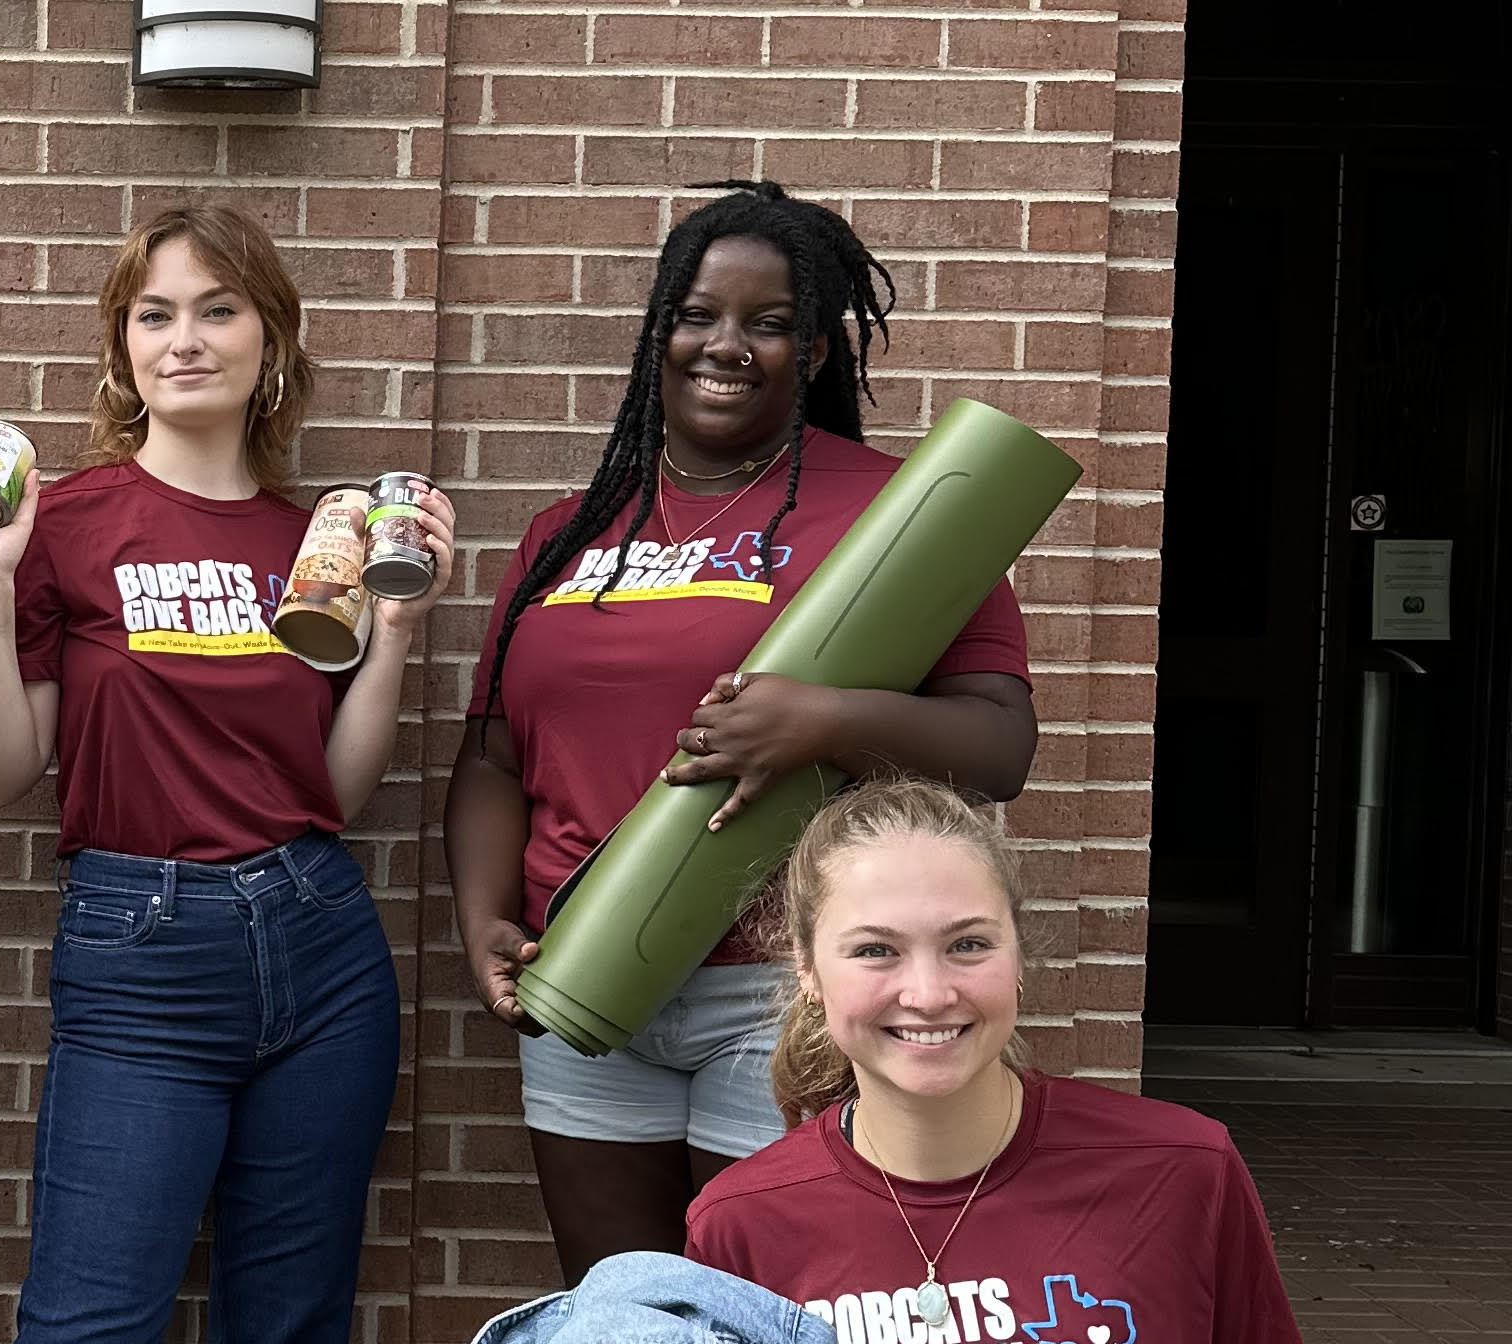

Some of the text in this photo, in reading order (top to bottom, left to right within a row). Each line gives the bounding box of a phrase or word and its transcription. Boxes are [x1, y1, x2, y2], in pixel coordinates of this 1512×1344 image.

[315, 516, 353, 531] Organ
[114, 559, 257, 603] BOBCATS
[613, 562, 704, 591] BACK
[123, 596, 270, 635] GIVE BACK
